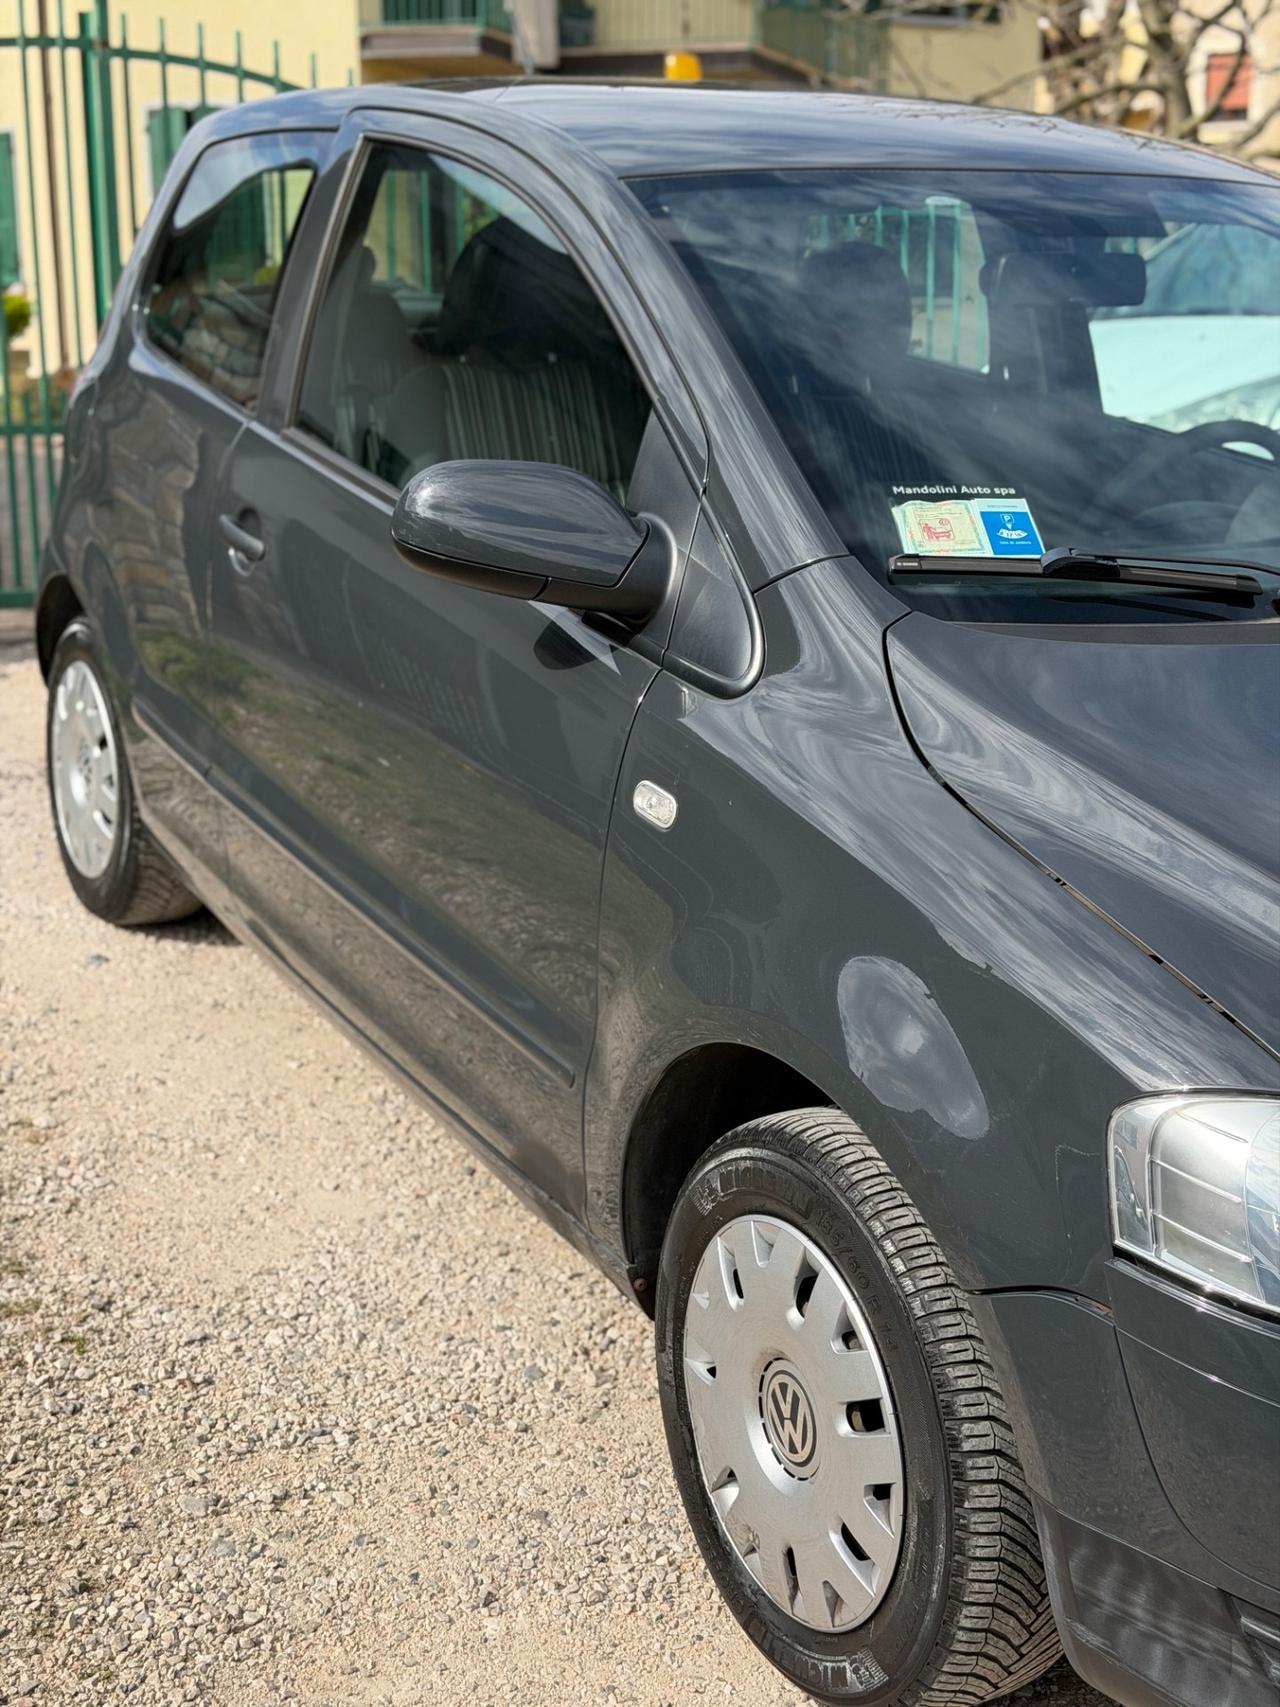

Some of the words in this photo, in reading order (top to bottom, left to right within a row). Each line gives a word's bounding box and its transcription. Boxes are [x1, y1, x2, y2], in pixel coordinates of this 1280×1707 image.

[892, 485, 957, 496] Mandolini
[960, 485, 991, 495] Auto
[994, 486, 1016, 497] spa
[769, 1377, 811, 1459] VW
